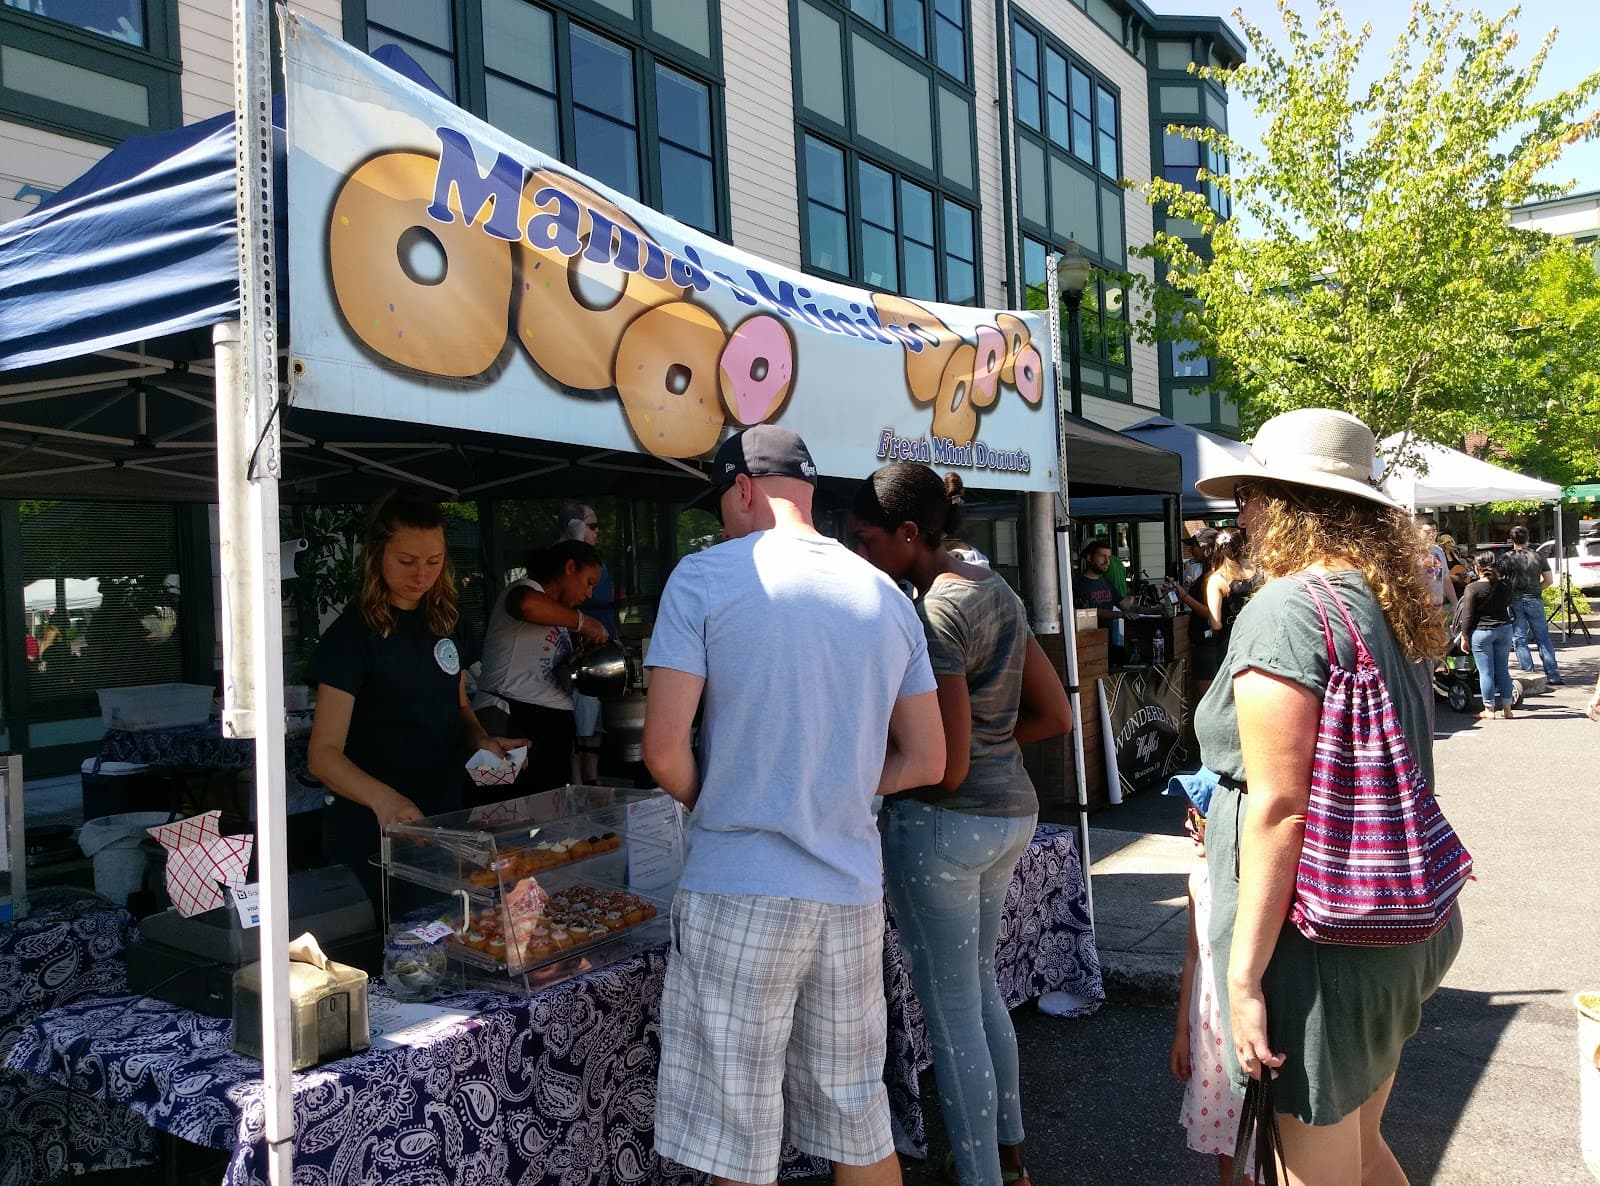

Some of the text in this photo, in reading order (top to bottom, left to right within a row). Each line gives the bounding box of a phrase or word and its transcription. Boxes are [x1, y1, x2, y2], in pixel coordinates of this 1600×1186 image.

[877, 428, 1031, 472] Fresh Mini Donuts
